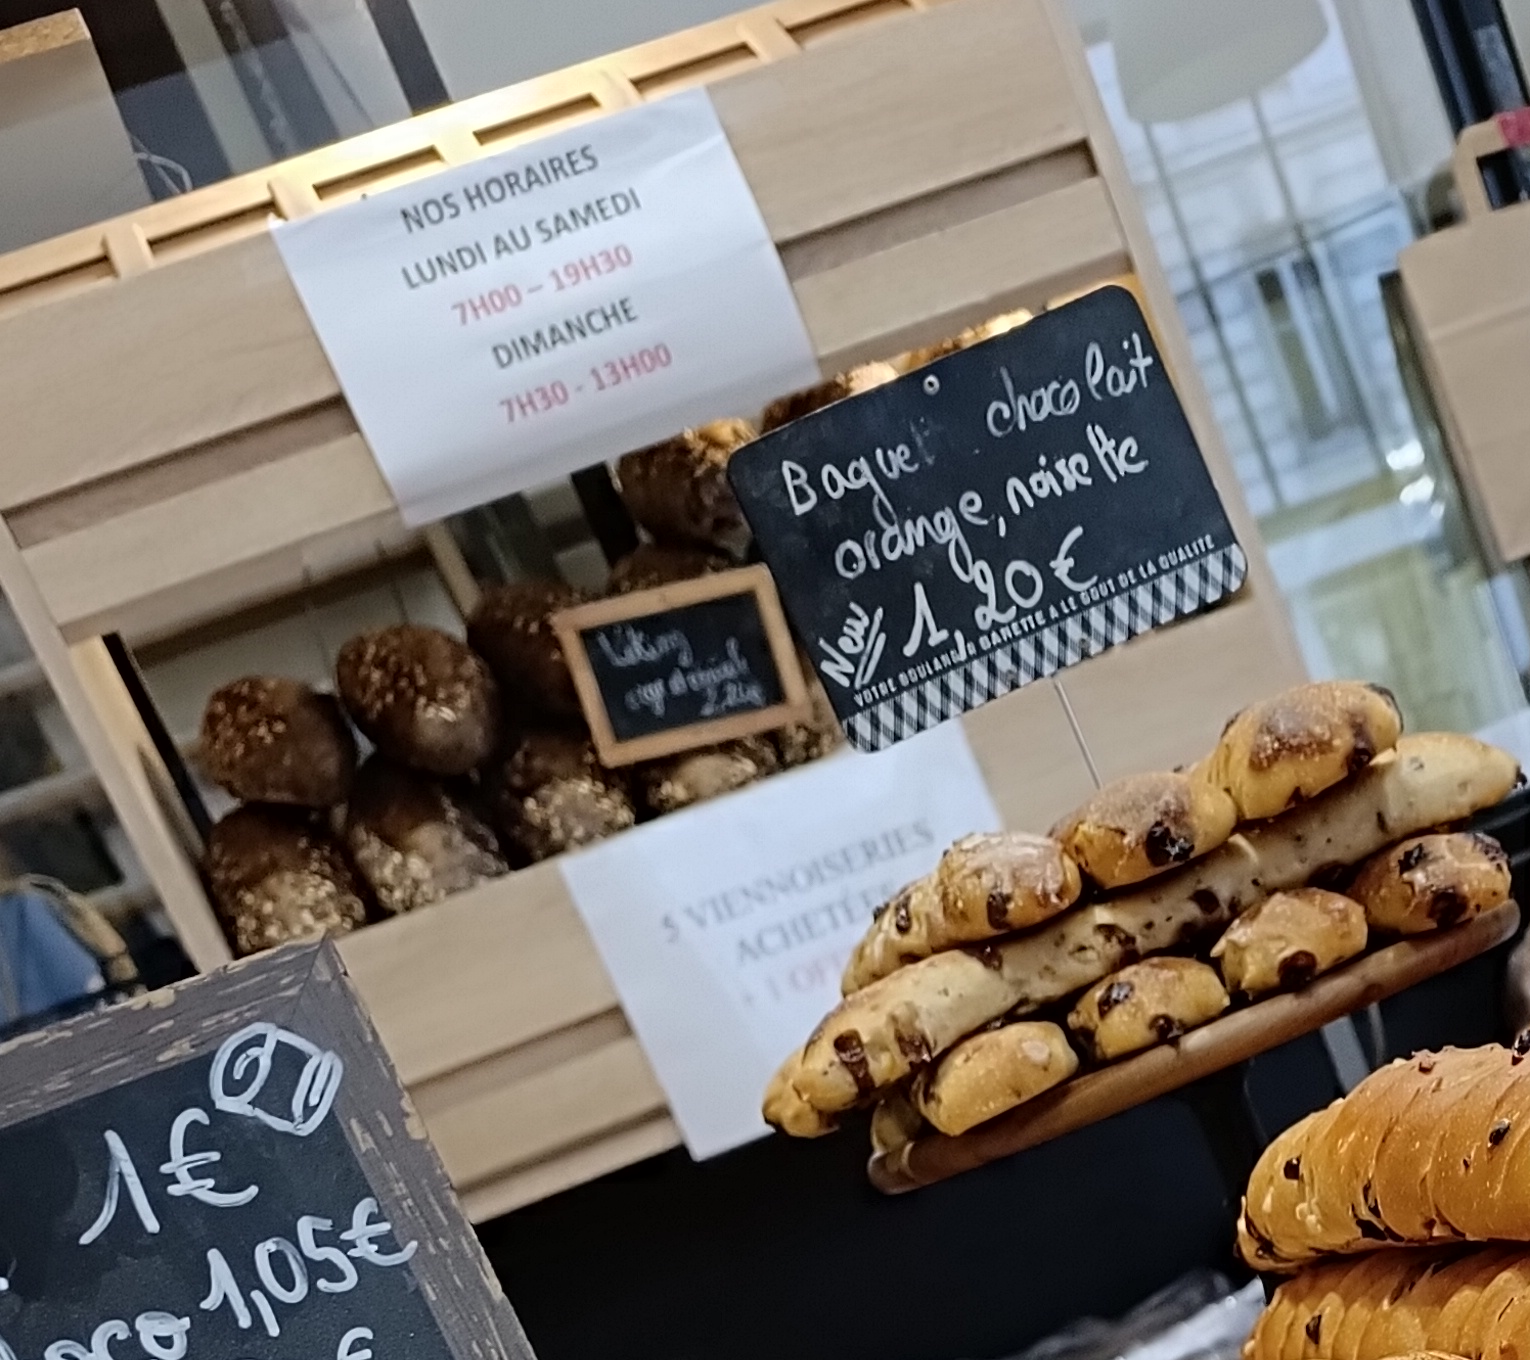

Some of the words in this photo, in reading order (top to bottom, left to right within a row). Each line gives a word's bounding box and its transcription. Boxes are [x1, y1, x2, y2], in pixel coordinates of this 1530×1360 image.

[401, 193, 461, 234] NOS
[463, 144, 600, 211] HORAIRES
[401, 240, 488, 290] LUNDI
[493, 224, 532, 261] AU
[537, 187, 643, 244] SAMEDI
[451, 282, 523, 326] 7H00
[549, 243, 634, 293] 19H30
[491, 297, 640, 369] DIMANCHE
[500, 382, 570, 424] 7H30
[590, 343, 674, 393] 13H00
[1006, 424, 1150, 515] noisette
[820, 602, 873, 688] New
[854, 677, 897, 706] VOTRE
[899, 641, 976, 687] BOULANGR
[1060, 596, 1078, 615] LE
[1118, 567, 1137, 588] DE
[1139, 560, 1157, 580] LA
[1158, 534, 1215, 568] QUALITE
[684, 820, 935, 928] VIENNOISERIES
[200, 1198, 418, 1336] 1,05€
